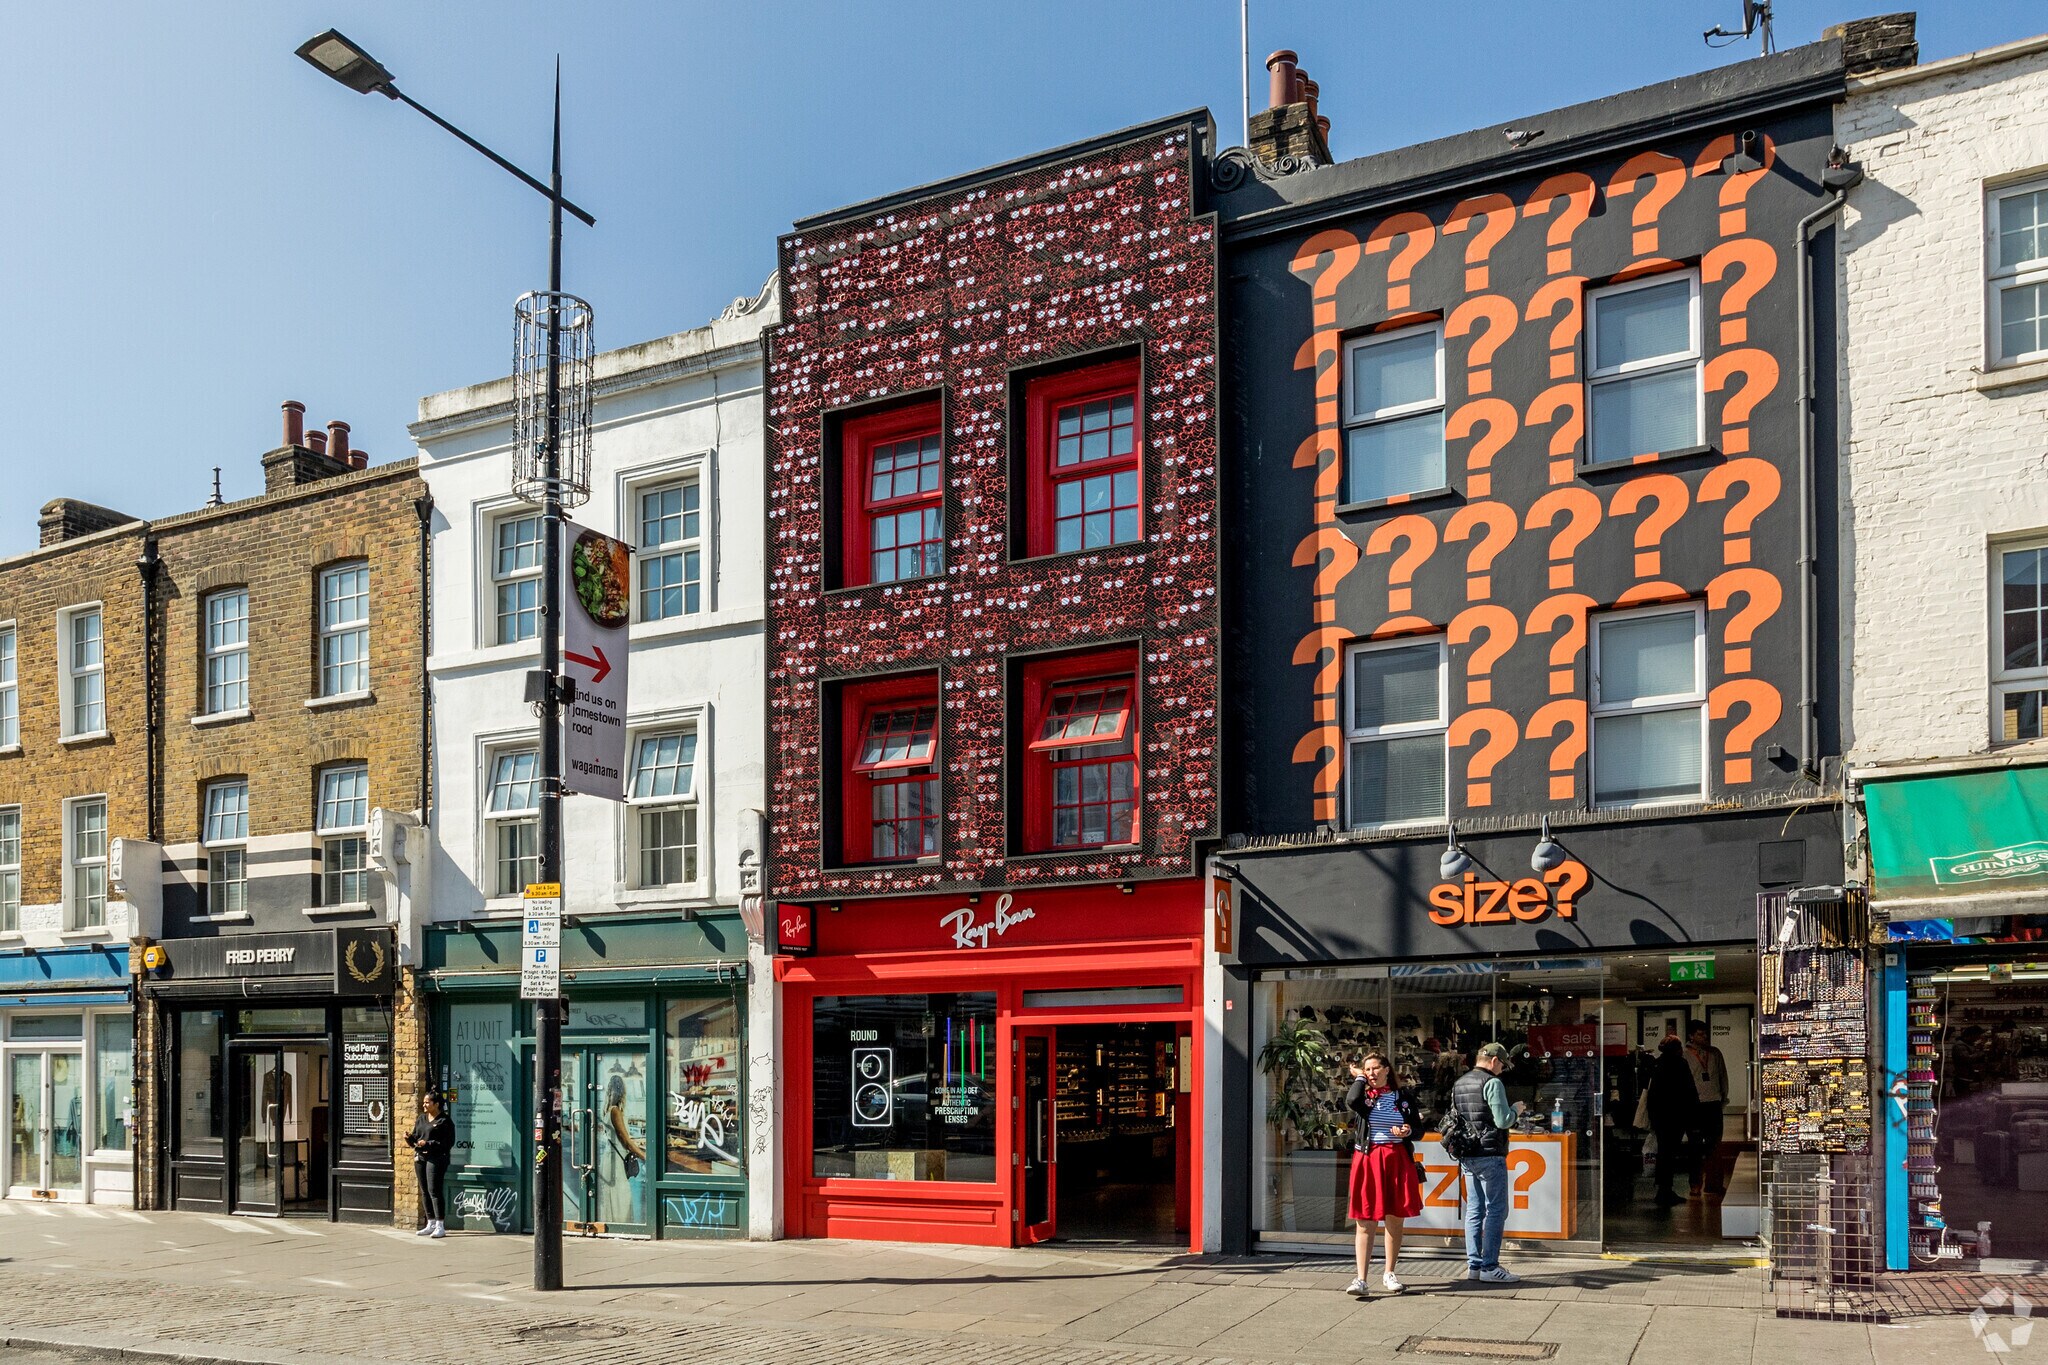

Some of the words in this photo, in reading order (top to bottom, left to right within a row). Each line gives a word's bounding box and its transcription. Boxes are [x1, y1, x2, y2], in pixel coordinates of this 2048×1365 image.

[575, 688, 590, 702] ind
[592, 695, 602, 706] us
[605, 699, 616, 710] on
[572, 704, 620, 726] jamestown
[572, 722, 592, 736] road
[572, 759, 618, 779] wagamama
[1428, 860, 1587, 925] size?
[226, 950, 255, 964] FRED
[256, 948, 295, 963] PERRY
[457, 1021, 468, 1040] A1
[474, 1021, 503, 1040] UNIT
[851, 1030, 877, 1041] ROUND
[1563, 1032, 1591, 1044] sale
[344, 1044, 359, 1052] Fred
[360, 1044, 379, 1053] Perry
[457, 1044, 471, 1063] TO
[477, 1044, 499, 1063] LET
[935, 1107, 978, 1115] PRESCRIPTION
